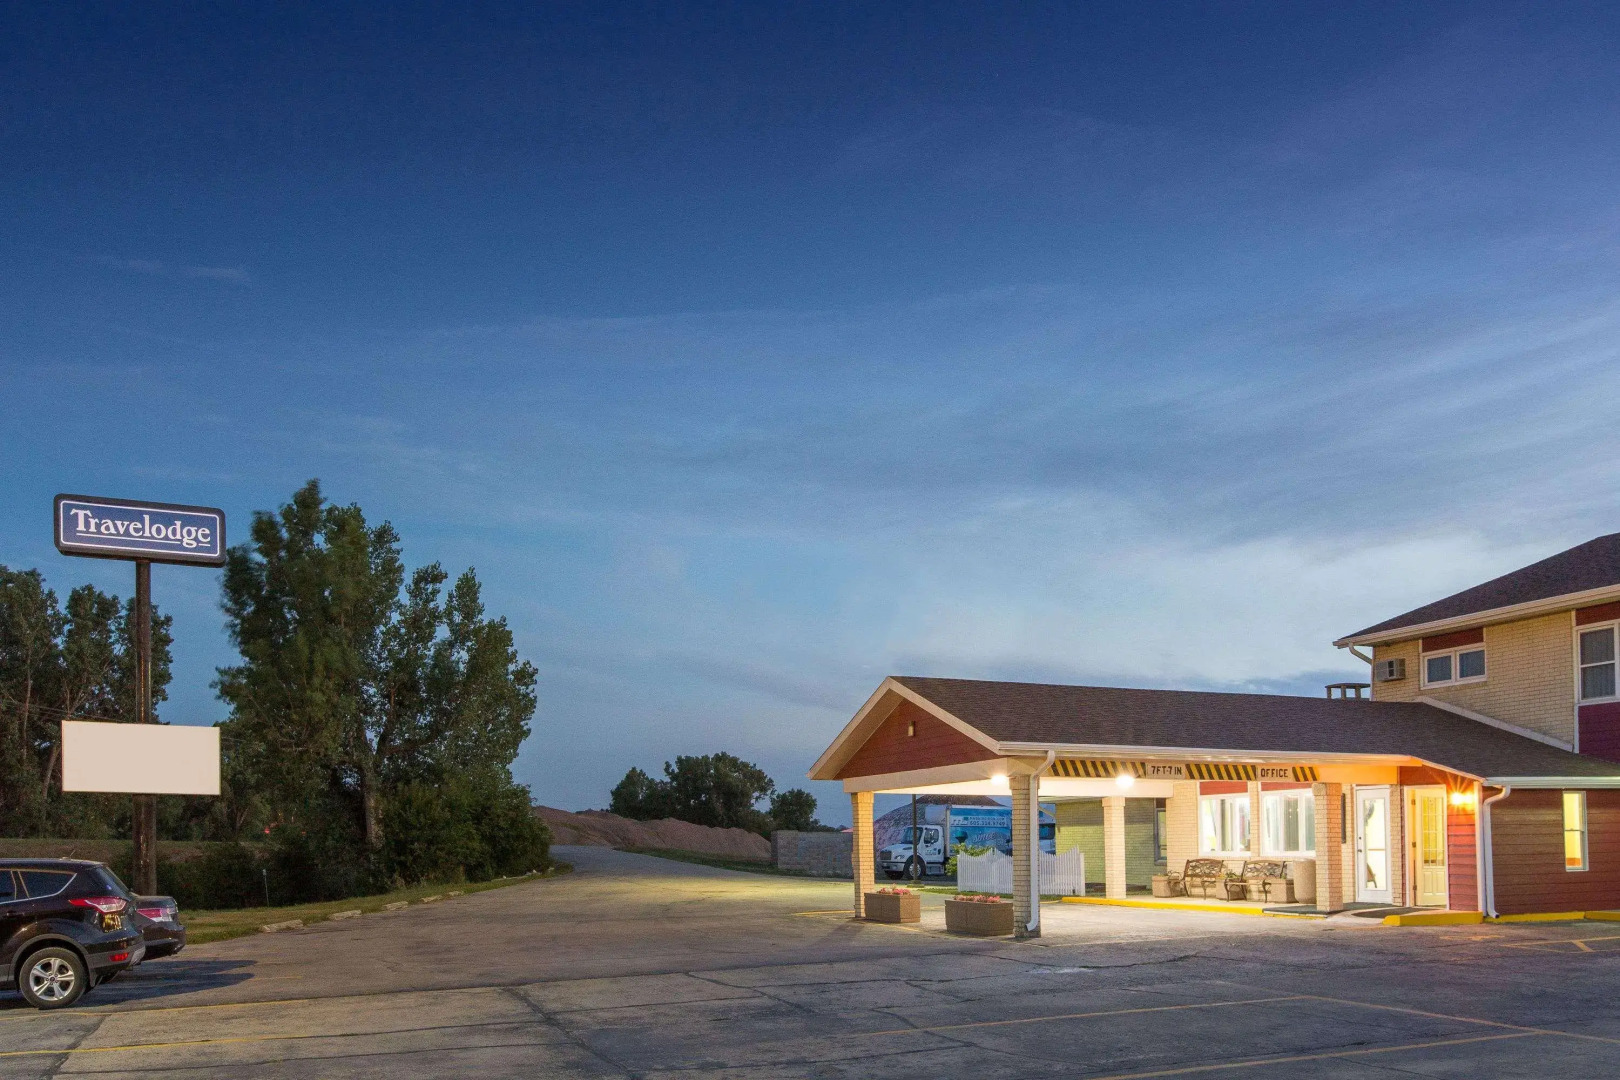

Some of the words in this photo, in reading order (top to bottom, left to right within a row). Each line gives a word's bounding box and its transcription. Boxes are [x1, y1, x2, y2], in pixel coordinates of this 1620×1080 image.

[69, 508, 211, 548] Travelodge
[1174, 766, 1182, 775] IN
[1260, 768, 1289, 778] OFFICE
